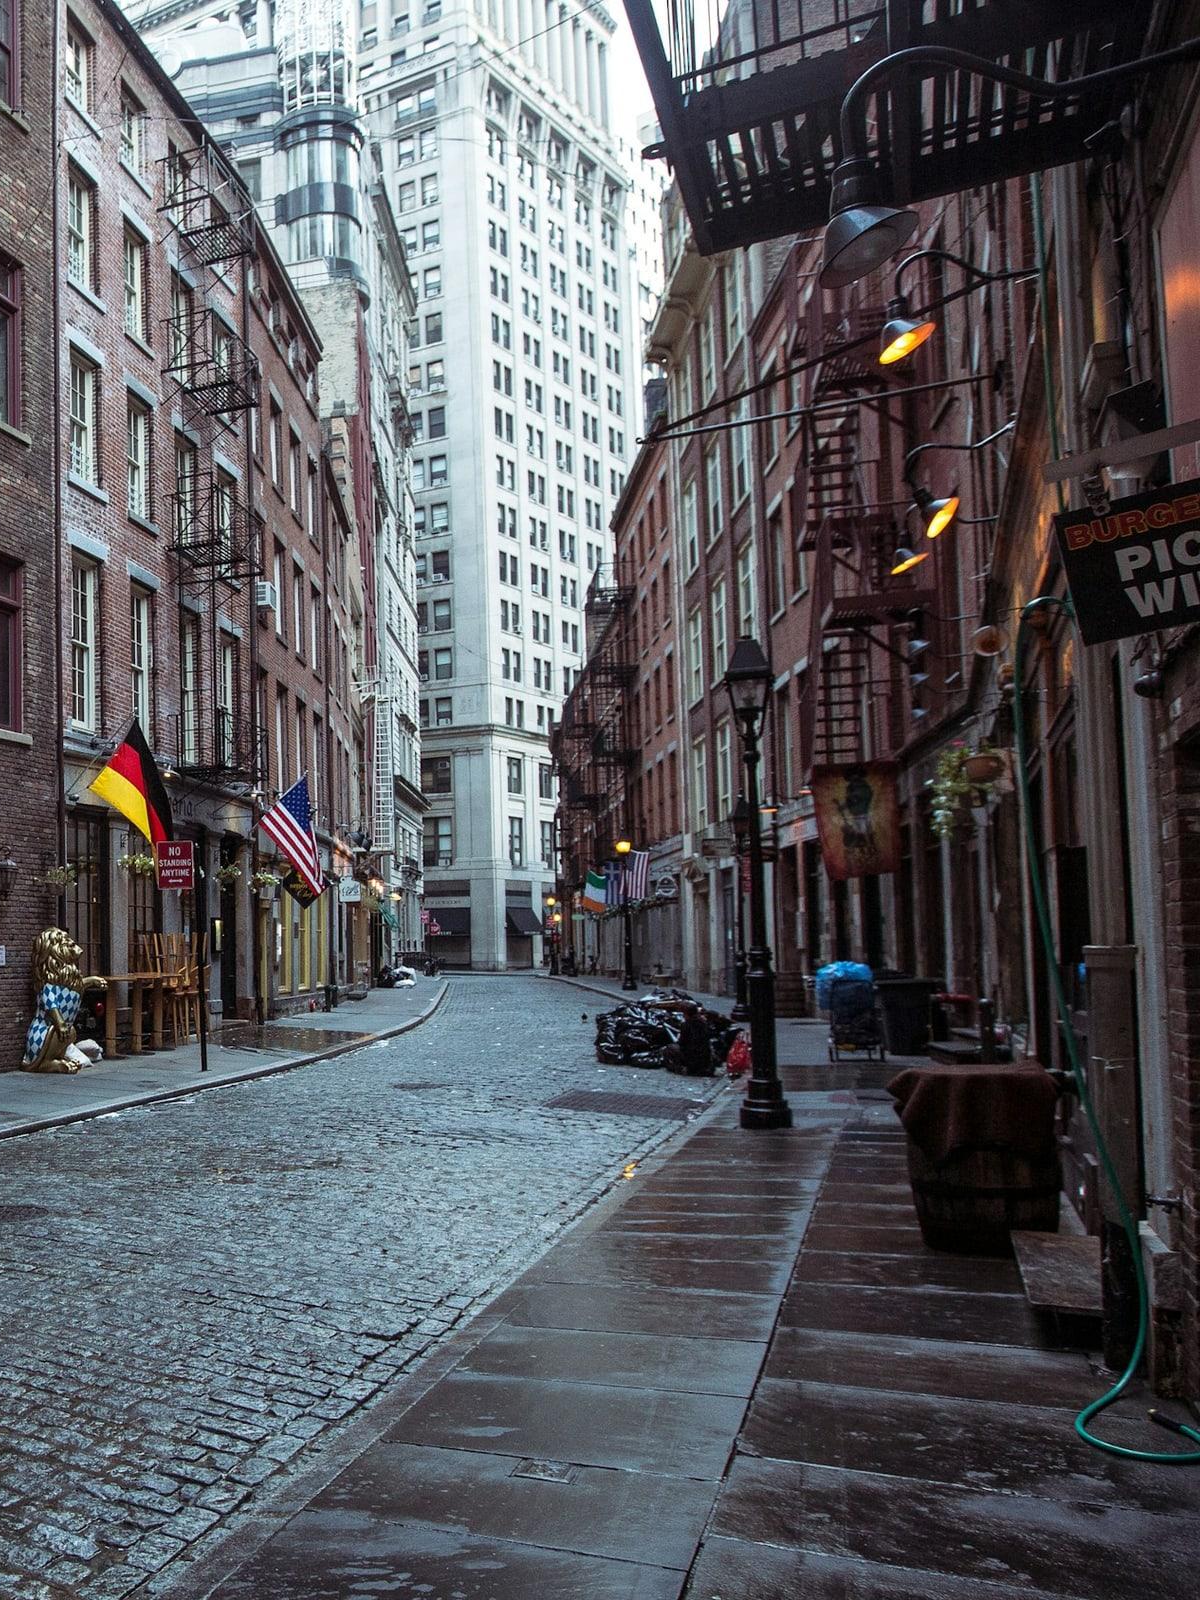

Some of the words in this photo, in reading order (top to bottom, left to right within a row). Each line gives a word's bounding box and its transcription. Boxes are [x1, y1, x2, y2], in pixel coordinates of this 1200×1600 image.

[1124, 571, 1200, 618] WI
[168, 846, 181, 856] NO
[158, 859, 192, 867] STANDING
[161, 868, 190, 877] ANYTIME
